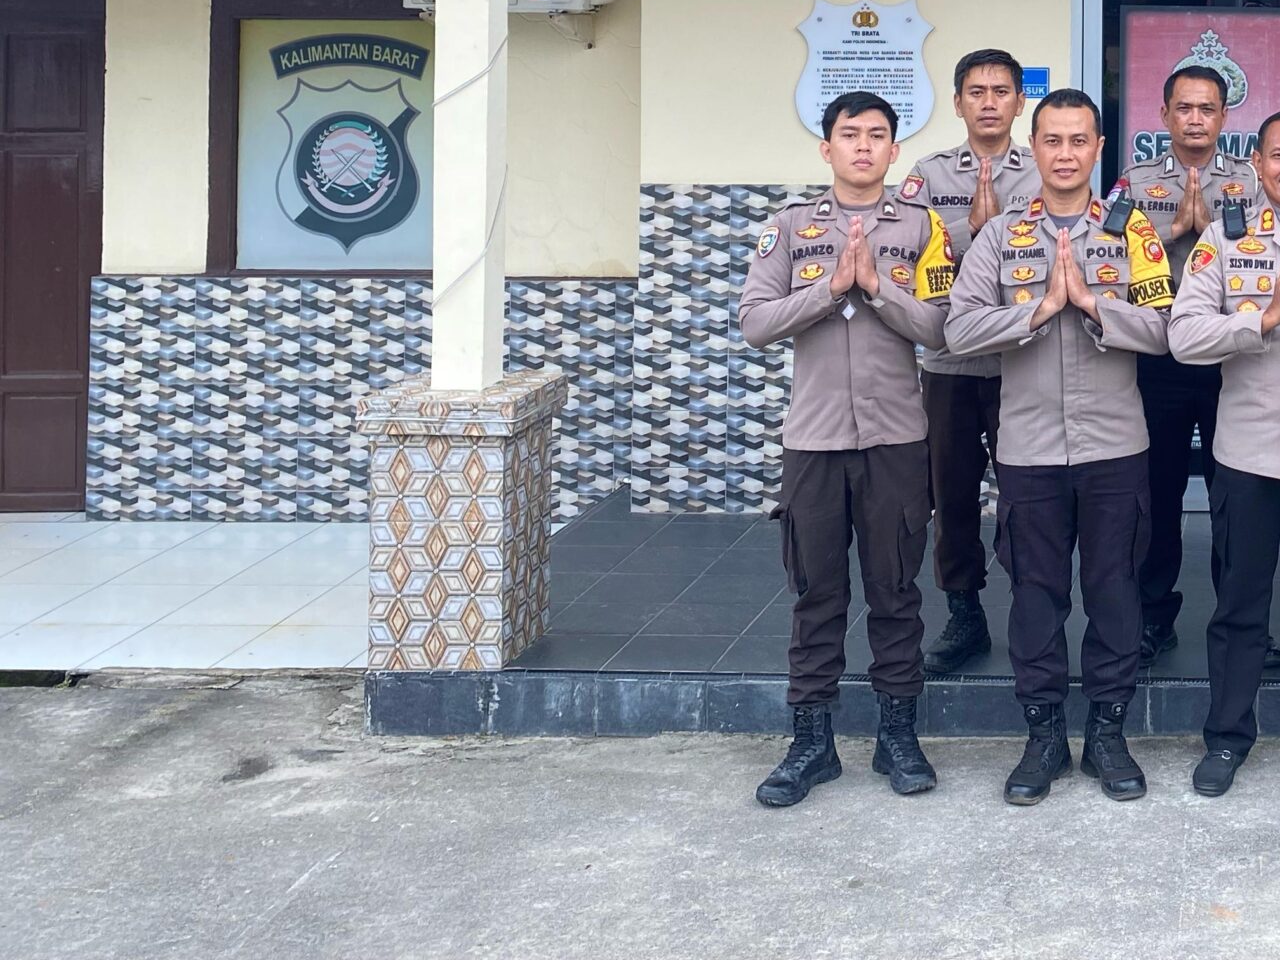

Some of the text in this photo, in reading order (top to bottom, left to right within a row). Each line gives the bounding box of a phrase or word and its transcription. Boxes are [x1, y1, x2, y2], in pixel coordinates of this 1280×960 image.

[280, 43, 420, 71] KALIMANTAN BARAT
[1023, 86, 1046, 95] SUK
[792, 244, 834, 262] ARANZO
[1002, 246, 1128, 261] VAN CHANEL POLRI
